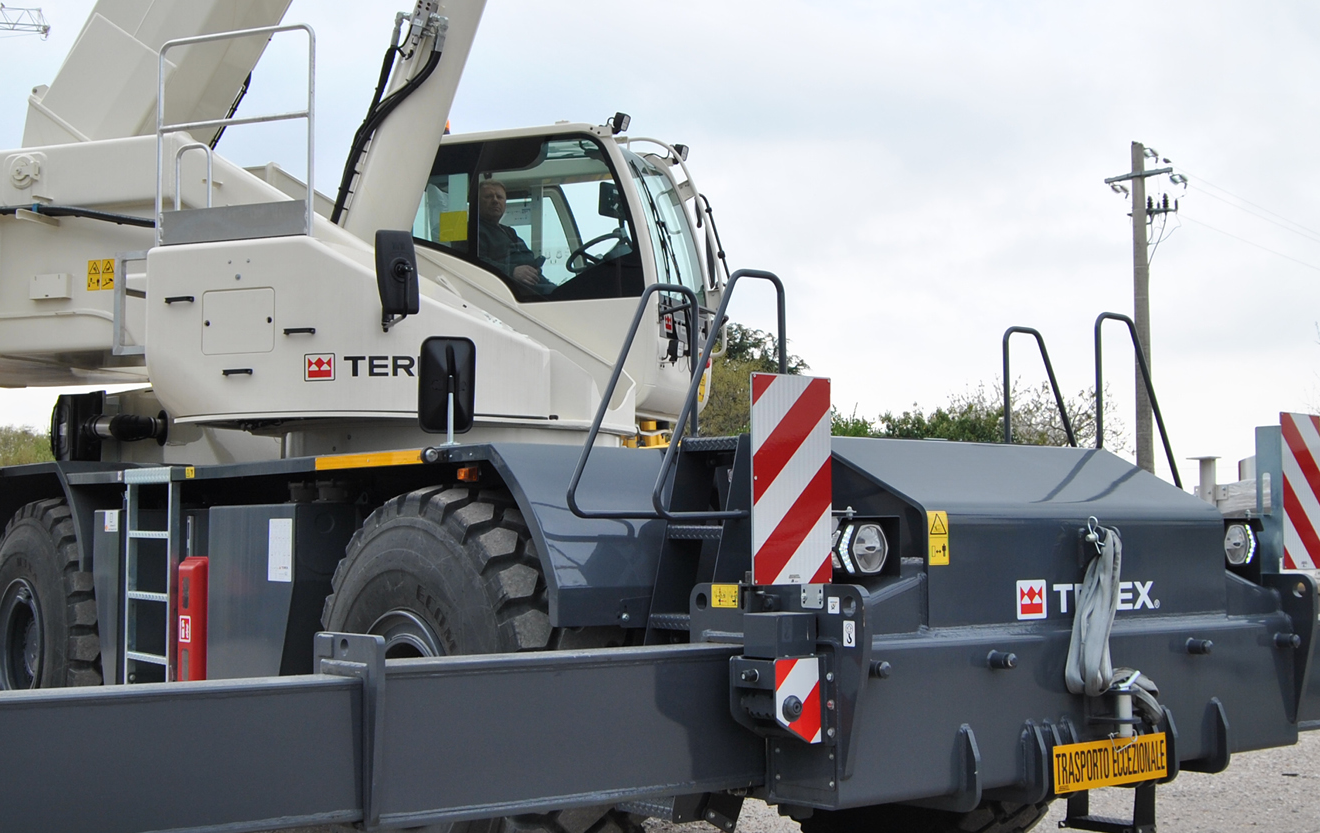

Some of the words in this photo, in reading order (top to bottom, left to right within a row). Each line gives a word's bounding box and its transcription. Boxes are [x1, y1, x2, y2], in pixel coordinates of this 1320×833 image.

[343, 355, 421, 378] TER
[1052, 580, 1156, 613] TEX
[1055, 747, 1110, 786] TRASPORTO
[1111, 739, 1166, 778] ECCEZIONALE
